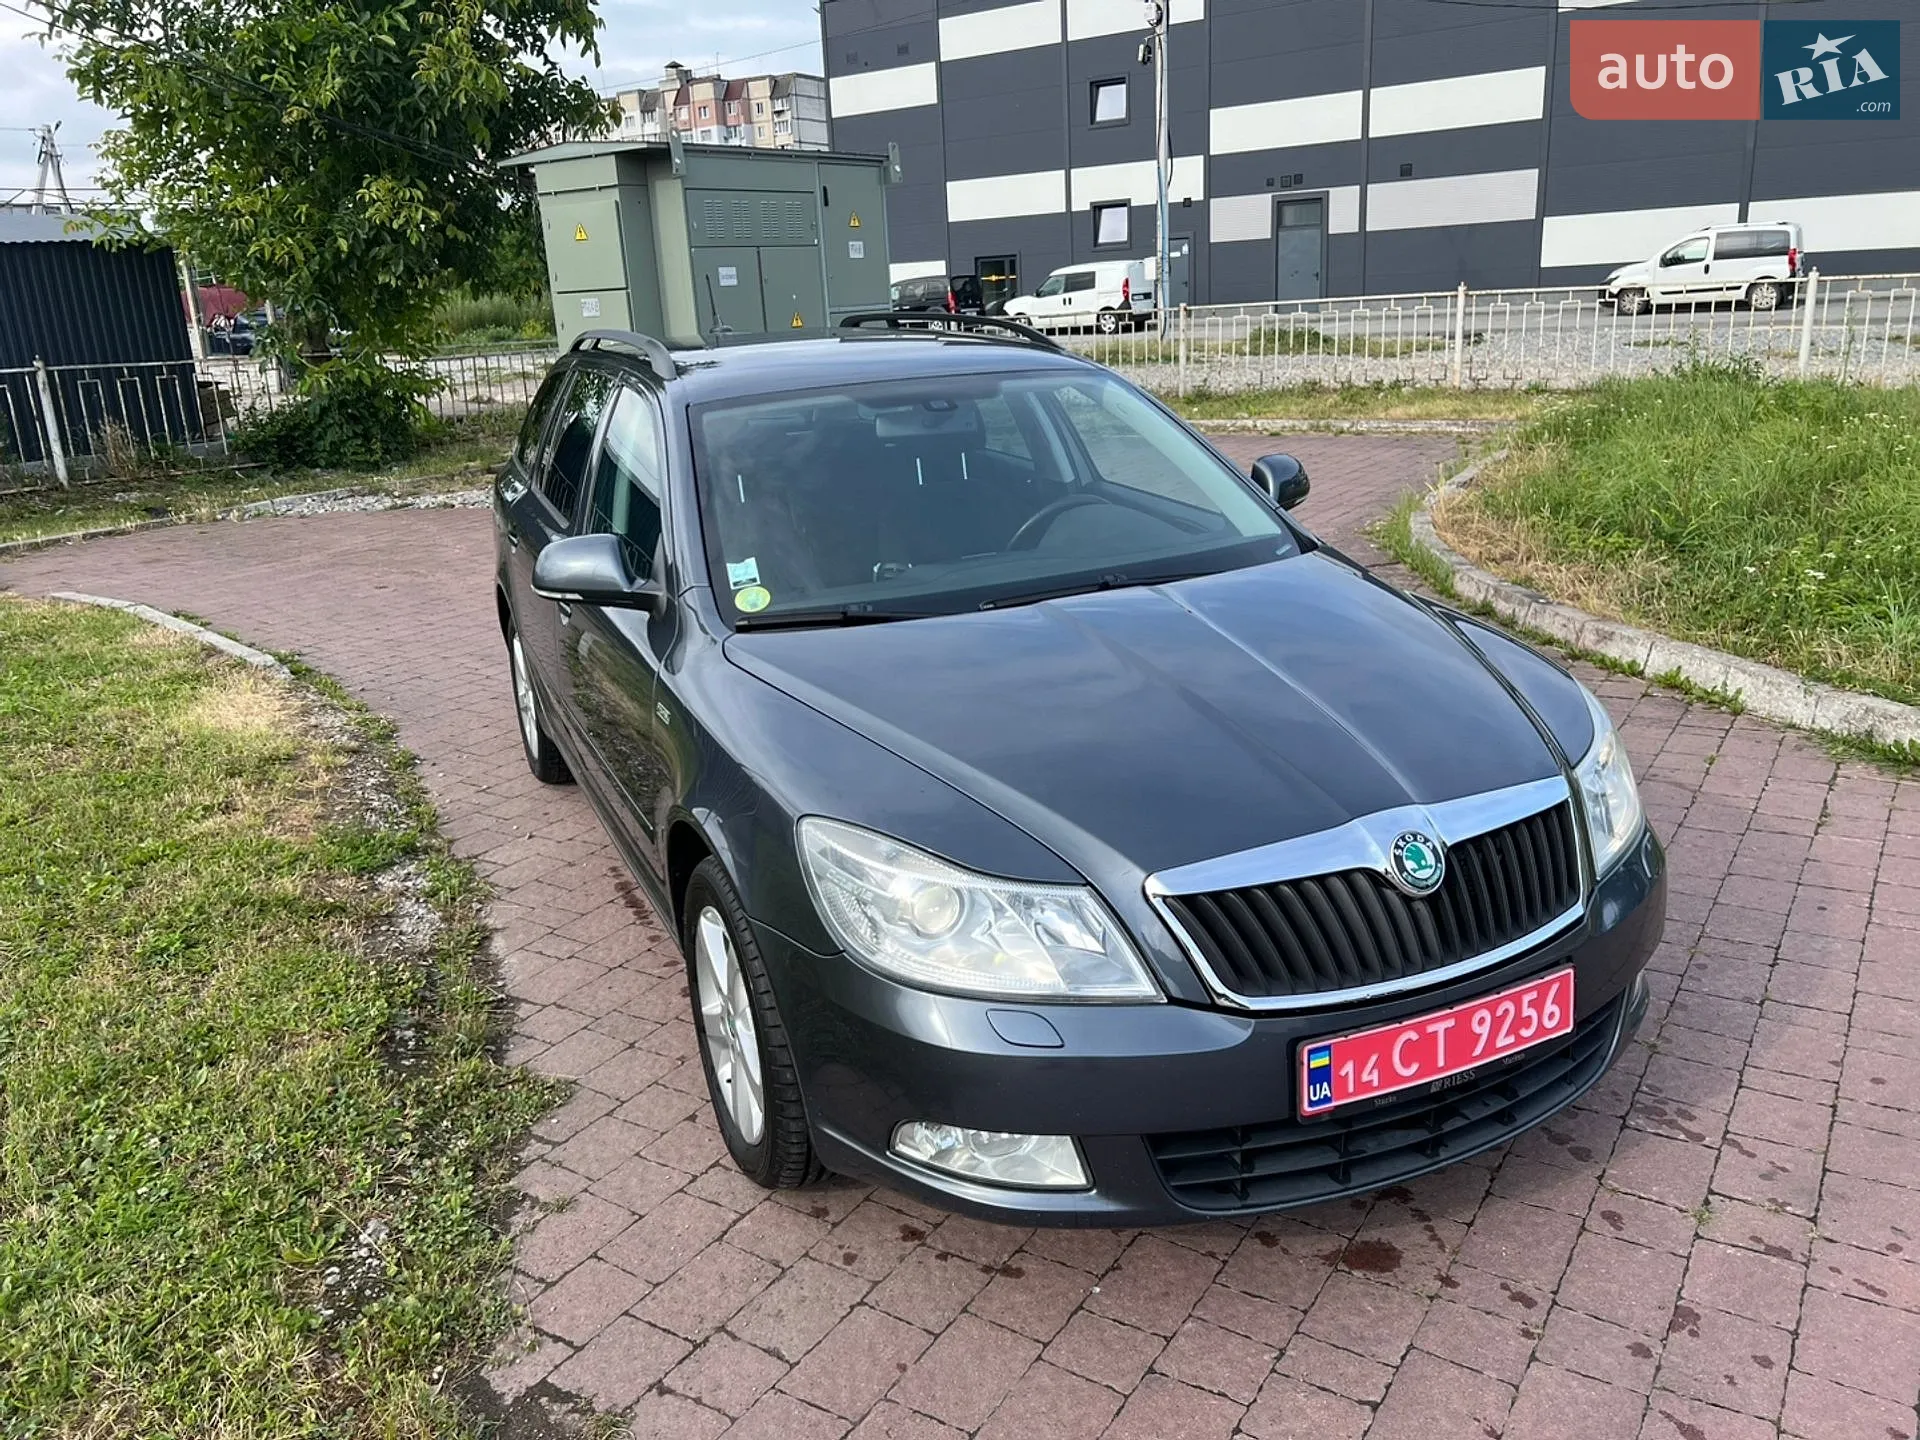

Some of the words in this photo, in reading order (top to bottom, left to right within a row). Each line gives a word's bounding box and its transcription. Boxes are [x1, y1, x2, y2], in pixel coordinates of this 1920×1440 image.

[1339, 1053, 1380, 1093] 14
[1392, 1018, 1455, 1077] CT
[1471, 981, 1561, 1057] 9256
[1309, 1082, 1331, 1101] UA
